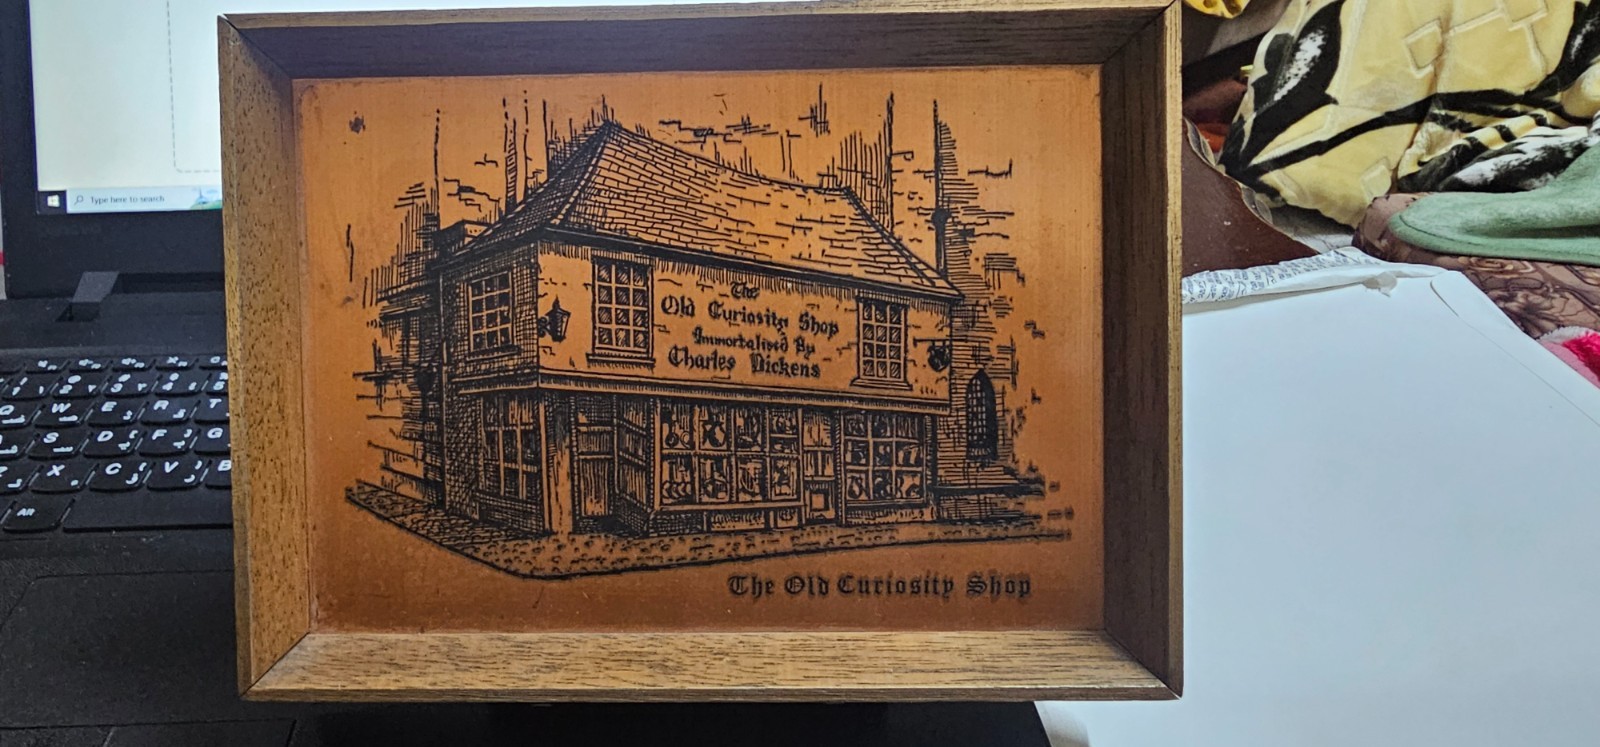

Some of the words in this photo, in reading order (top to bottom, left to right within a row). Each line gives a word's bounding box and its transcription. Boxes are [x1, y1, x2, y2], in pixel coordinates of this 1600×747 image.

[90, 195, 109, 206] Type
[111, 195, 128, 203] here
[129, 195, 138, 203] to
[140, 193, 165, 203] search
[731, 281, 760, 300] The
[661, 295, 695, 317] Old
[708, 300, 788, 331] Curiosity
[798, 311, 840, 340] Shop
[793, 336, 816, 360] By
[668, 344, 736, 371] Charles
[750, 351, 821, 379] Dickens
[51, 402, 72, 414] W
[101, 401, 117, 412] E
[153, 399, 170, 411] R
[209, 398, 222, 409] T
[43, 432, 59, 444] S
[97, 430, 114, 442] D
[151, 429, 168, 441] F
[207, 427, 224, 439] G
[46, 464, 66, 477] X
[105, 462, 122, 475] C
[164, 461, 179, 473] V
[217, 459, 232, 472] B
[727, 573, 775, 600] The
[784, 573, 830, 598] Old
[837, 572, 954, 599] Curiosity
[966, 570, 1032, 599] Shop
